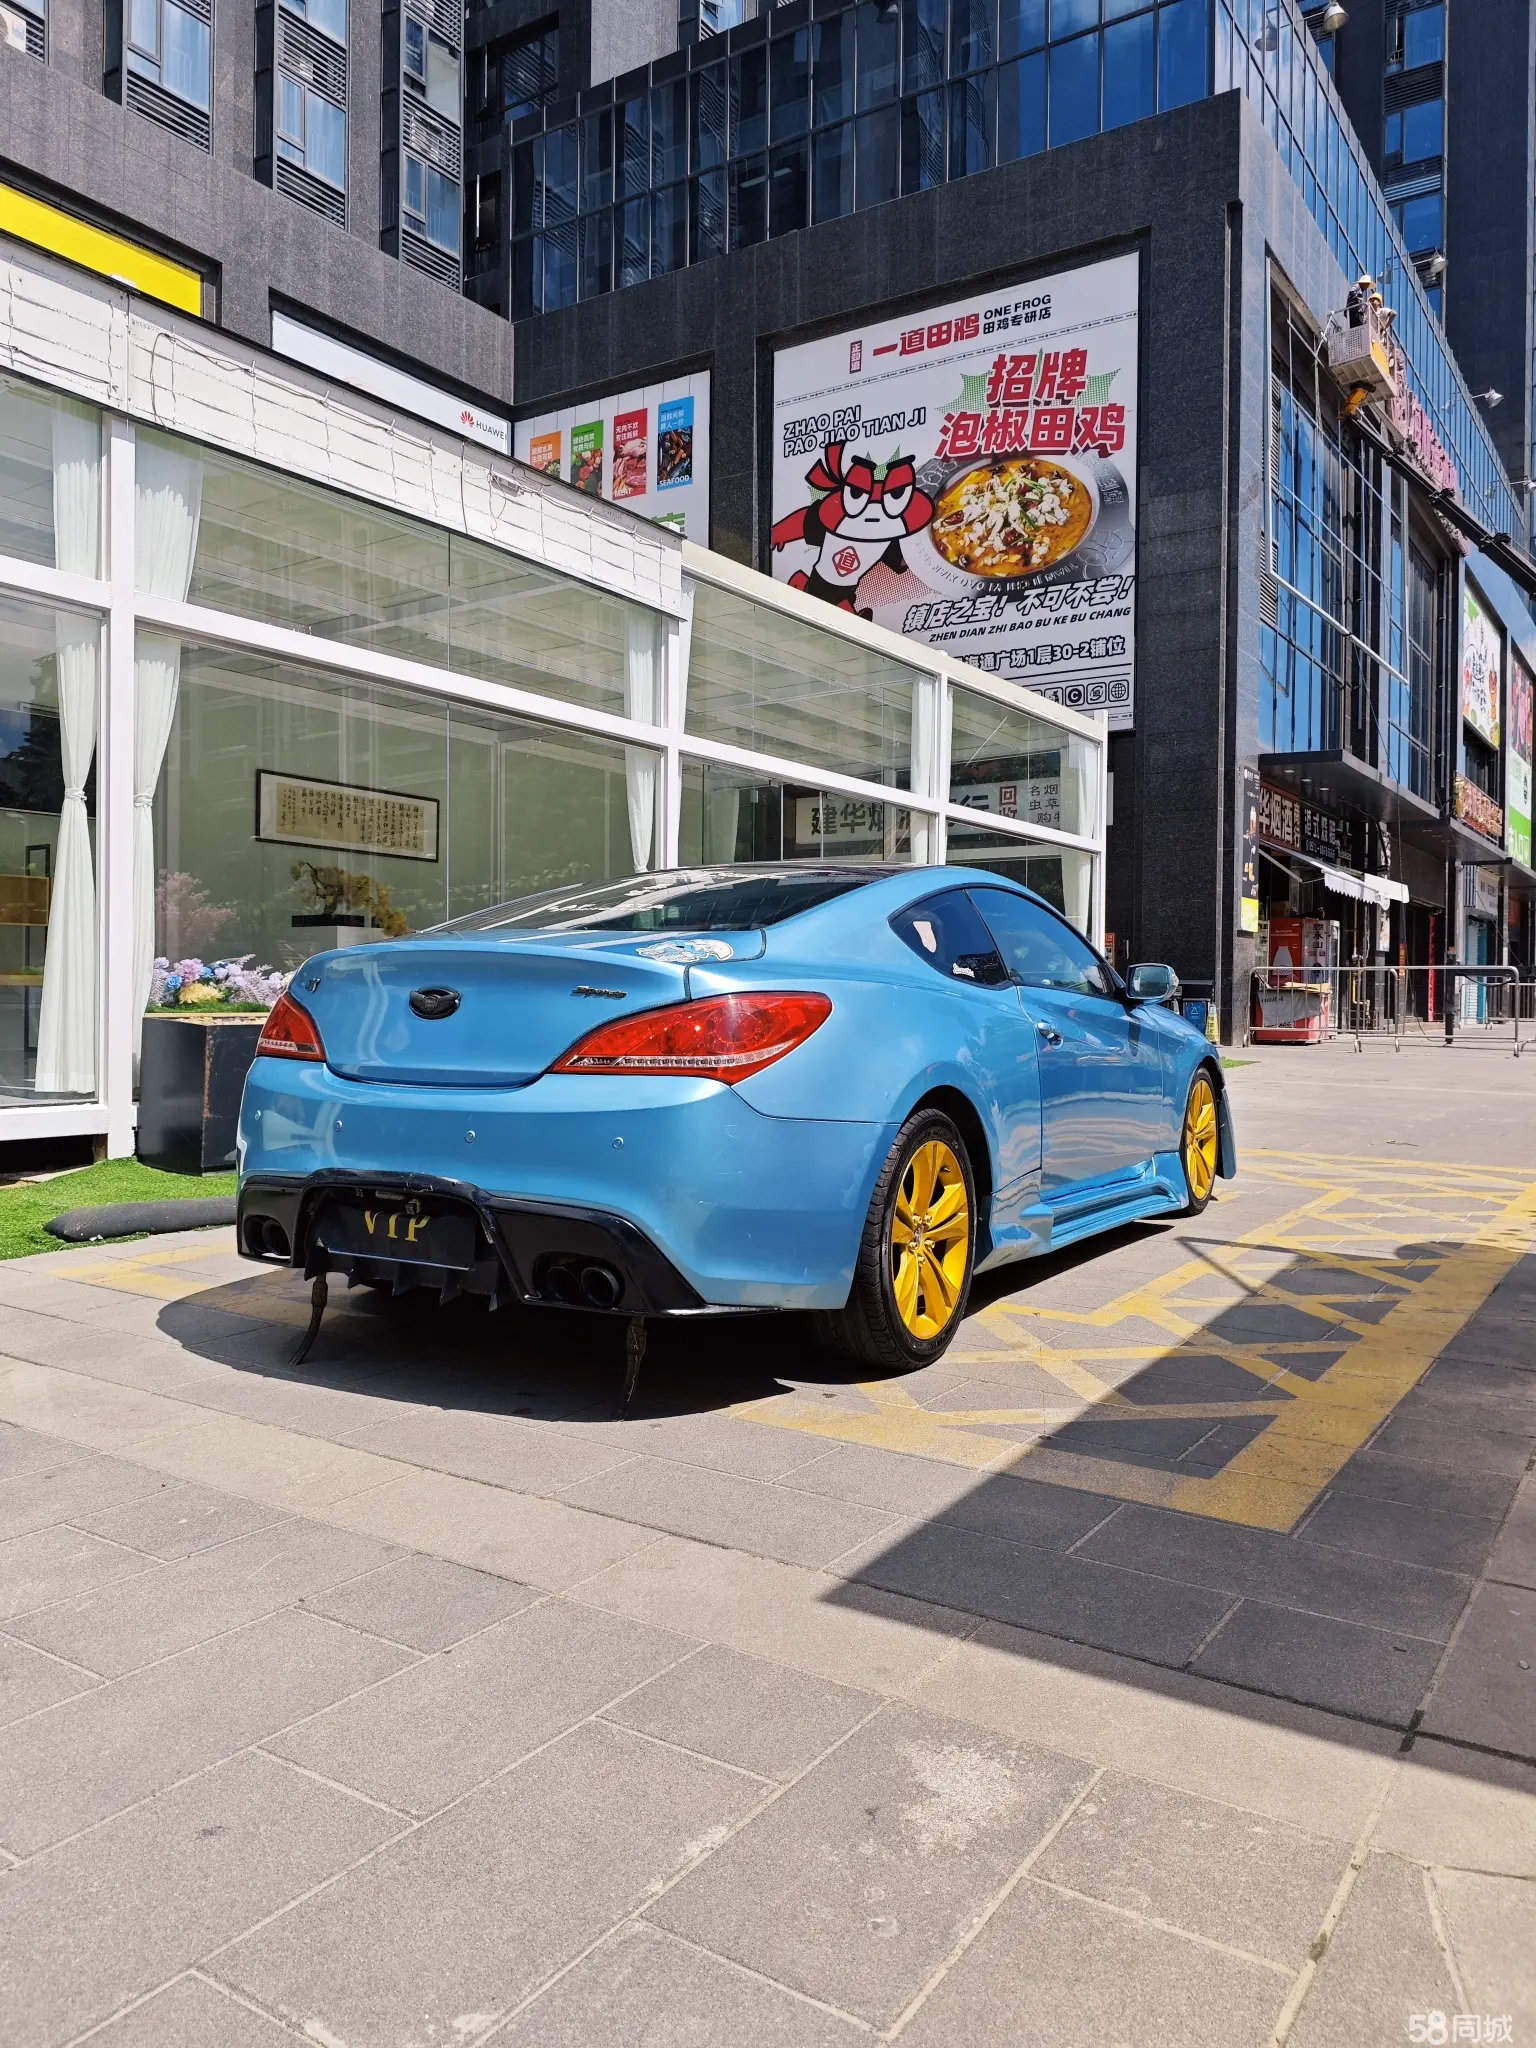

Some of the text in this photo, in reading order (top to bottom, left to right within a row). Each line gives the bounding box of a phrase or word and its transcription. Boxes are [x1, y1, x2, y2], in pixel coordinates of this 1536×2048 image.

[983, 306, 1052, 335] 田鸡专研店
[984, 295, 1052, 320] ONE FROG
[873, 313, 980, 357] 一道田鸡
[986, 348, 1088, 404] 招牌
[784, 405, 861, 440] ZHAO PAI
[784, 406, 926, 458] PAO JIAO TIAN JI
[935, 403, 1126, 459] 泡椒田鸡
[613, 487, 633, 497] MEAT
[659, 475, 690, 486] SEAFOOD
[928, 607, 1131, 643] ZHEN DIAN ZHI BAO BU KE BU CHANG
[364, 1210, 431, 1242] VIP
